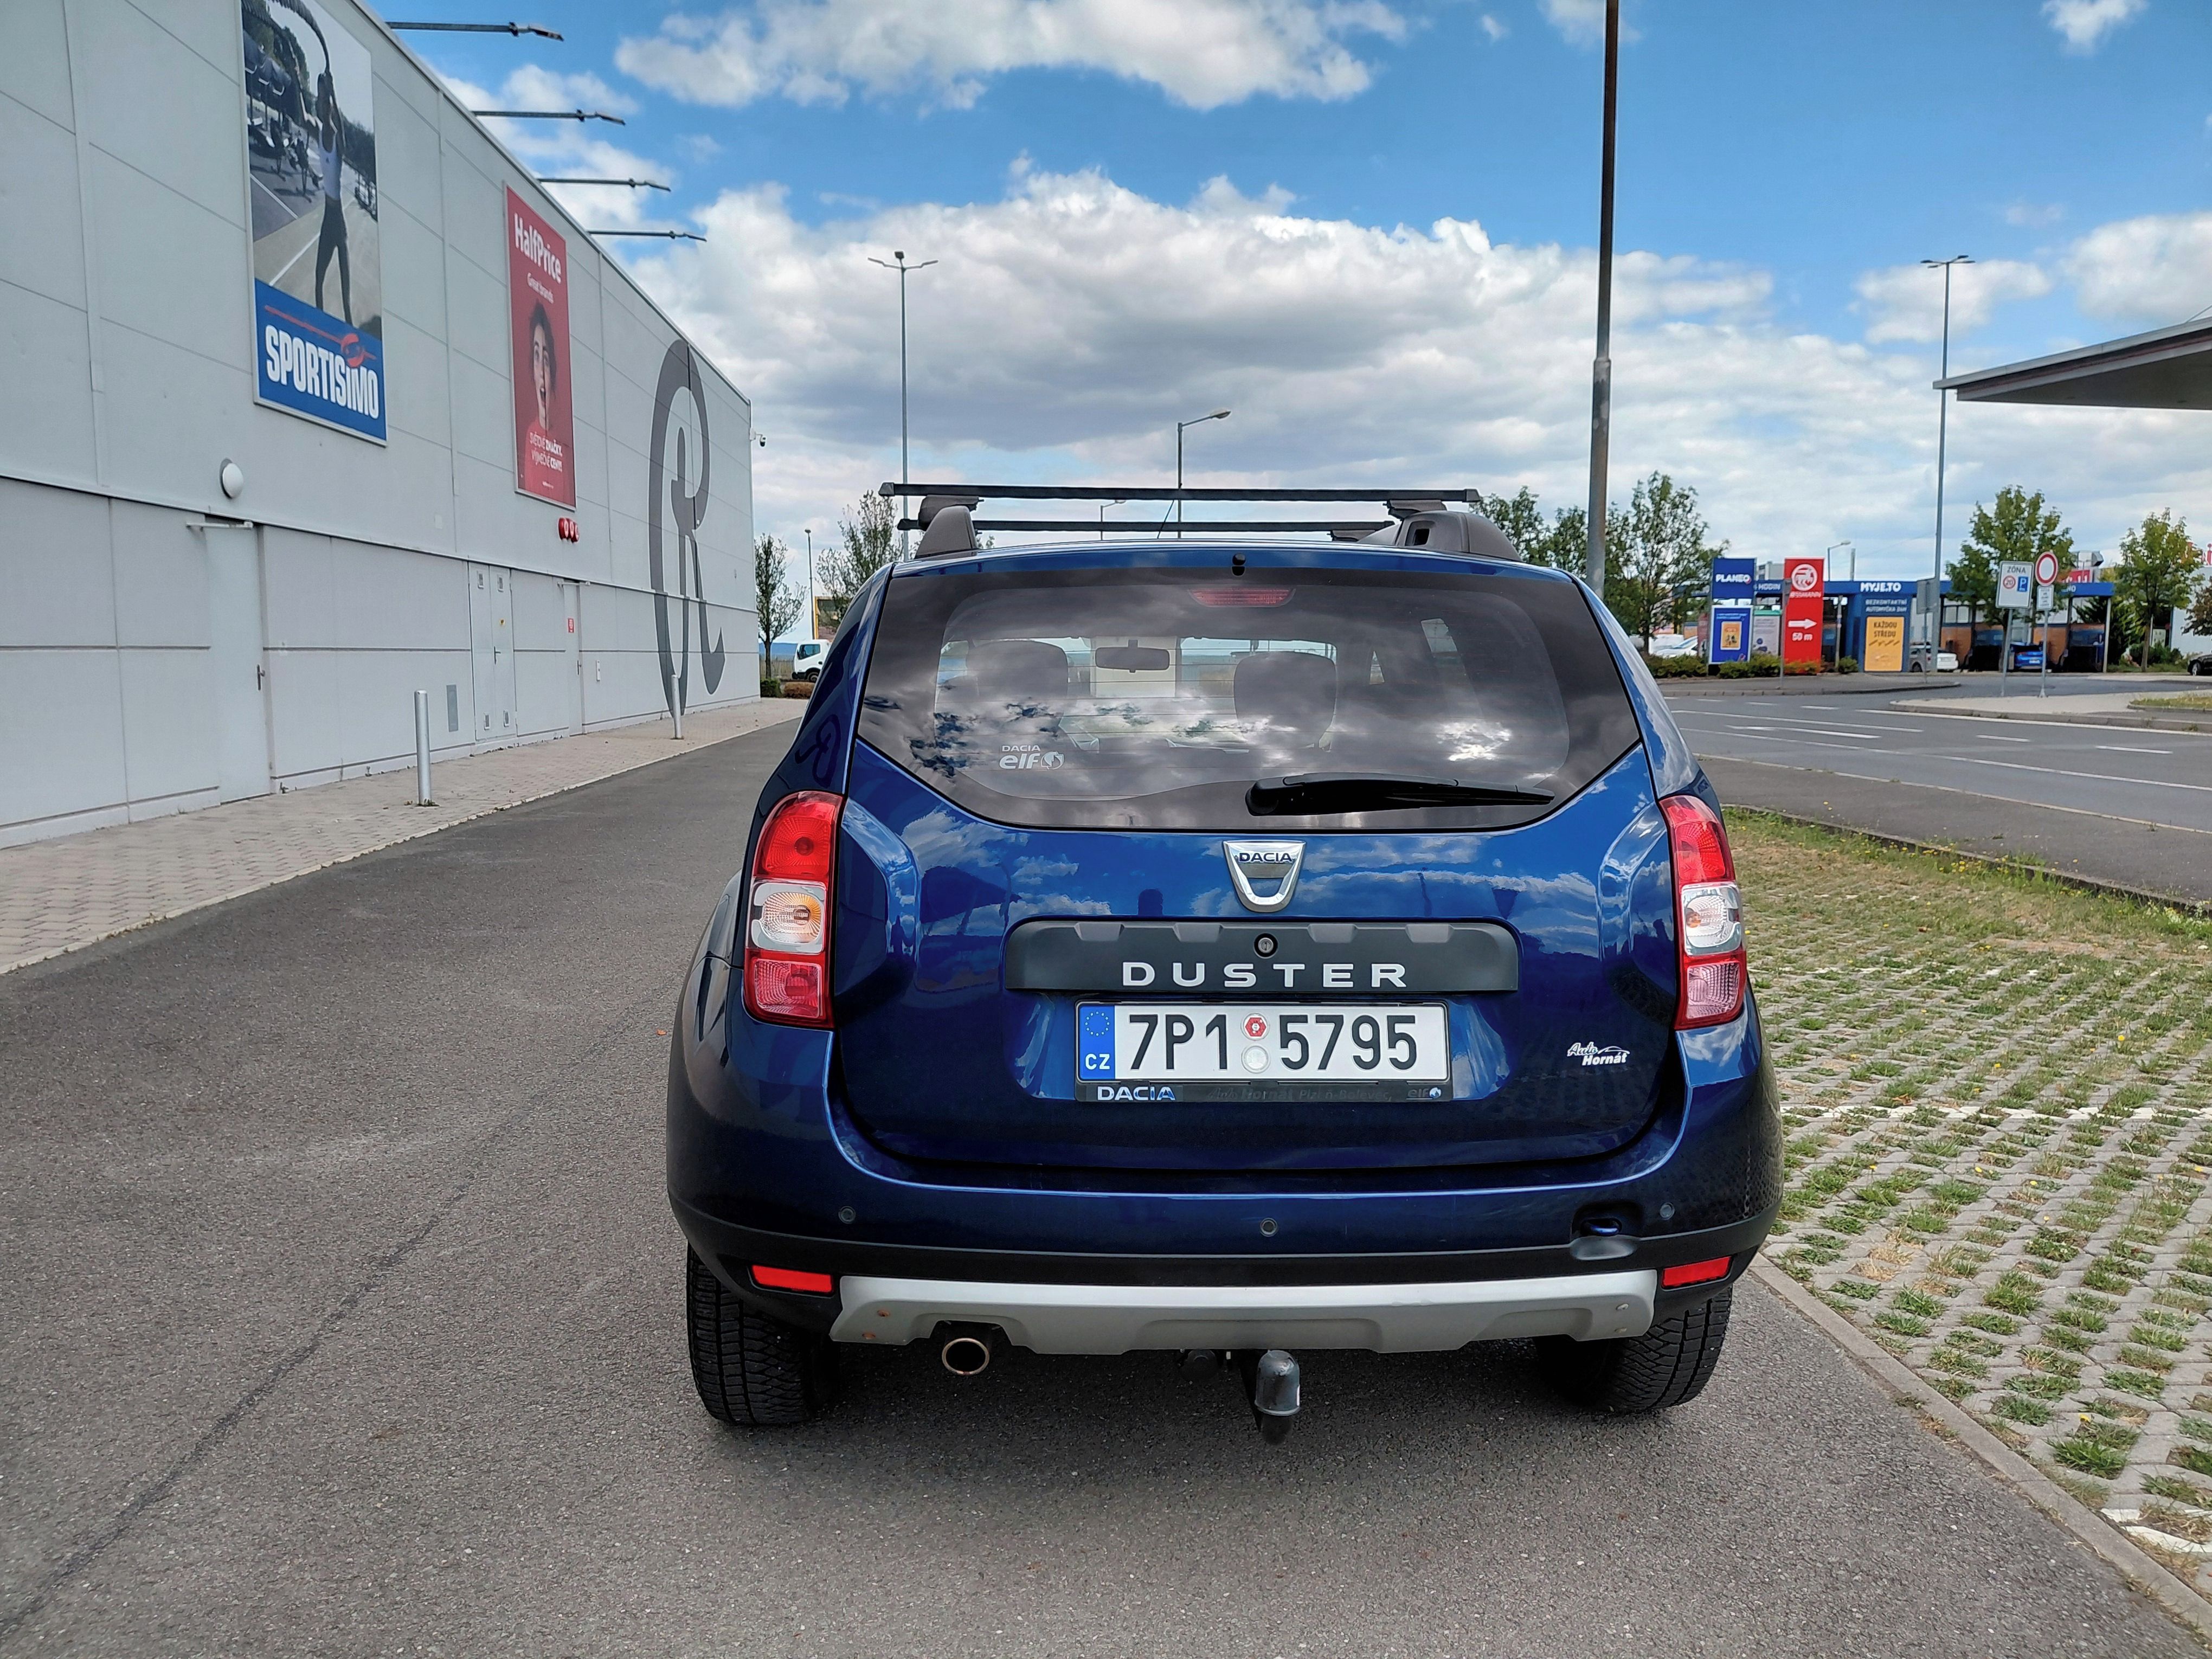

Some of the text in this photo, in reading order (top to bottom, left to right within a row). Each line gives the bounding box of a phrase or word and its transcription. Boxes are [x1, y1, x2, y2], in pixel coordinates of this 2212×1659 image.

[514, 212, 562, 285] HalfPrice
[266, 325, 379, 419] SPORTISIMO
[2007, 565, 2026, 574] ZÓNA
[1715, 574, 1752, 584] PLANEO
[1860, 582, 1902, 593] MYJE.TO
[1873, 629, 1896, 638] STŘEDU
[999, 753, 1041, 769] elf
[1239, 852, 1293, 863] DACIA
[1123, 962, 1407, 988] DUSTER
[1129, 1014, 1417, 1070] 7P1 5795
[1566, 1041, 1599, 1057] Auto
[1085, 1053, 1110, 1070] CZ
[1581, 1052, 1628, 1066] Hornát
[1097, 1086, 1175, 1101] DACIA
[1407, 1088, 1429, 1098] elf
